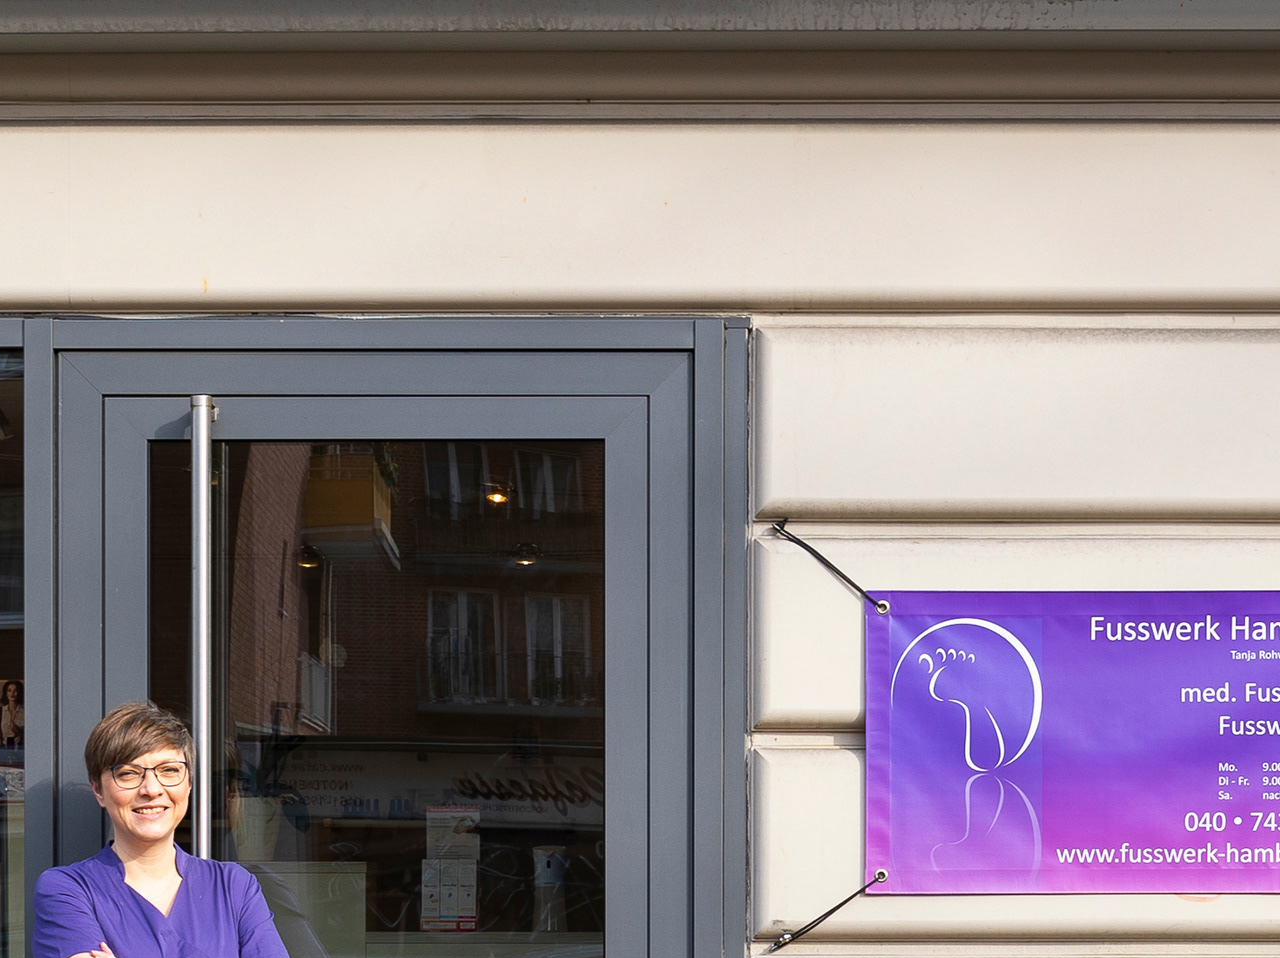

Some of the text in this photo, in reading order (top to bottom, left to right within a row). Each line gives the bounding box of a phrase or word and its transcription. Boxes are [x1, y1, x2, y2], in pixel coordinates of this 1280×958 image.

[1090, 614, 1221, 641] Fusswerk
[1230, 650, 1257, 662] Tanja
[1181, 681, 1237, 703] med.
[1218, 762, 1238, 772] Mo.
[1218, 776, 1228, 786] Di
[1238, 776, 1250, 786] Fr.
[1218, 790, 1233, 800] Sa.
[1184, 811, 1227, 832] 040
